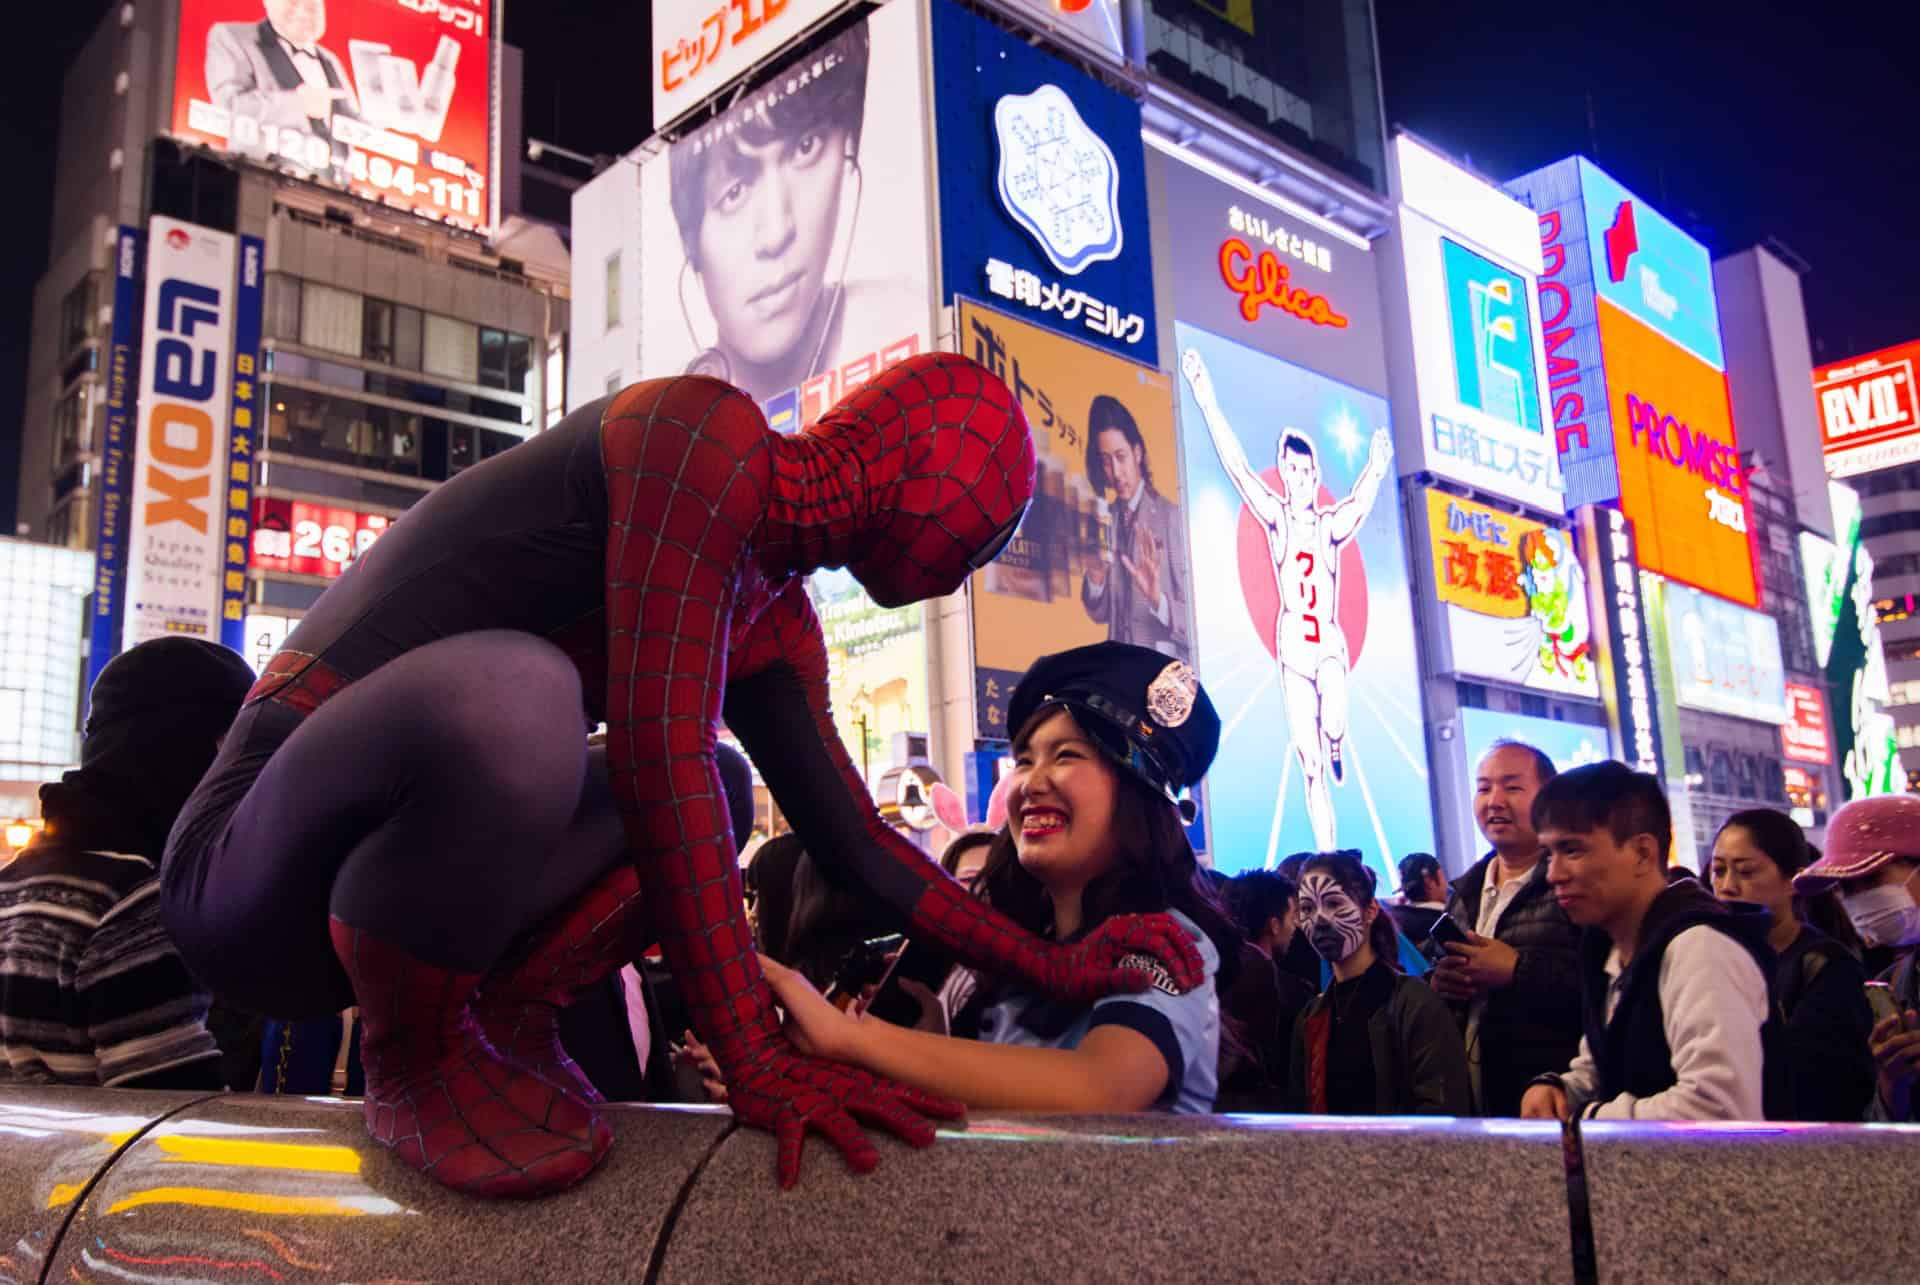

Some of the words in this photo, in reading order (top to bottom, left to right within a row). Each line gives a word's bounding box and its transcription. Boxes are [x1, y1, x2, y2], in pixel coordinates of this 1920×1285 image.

[985, 257, 1145, 344] 雪印メグミルク
[1219, 237, 1348, 329] Glico
[1626, 392, 1744, 497] PROMISE
